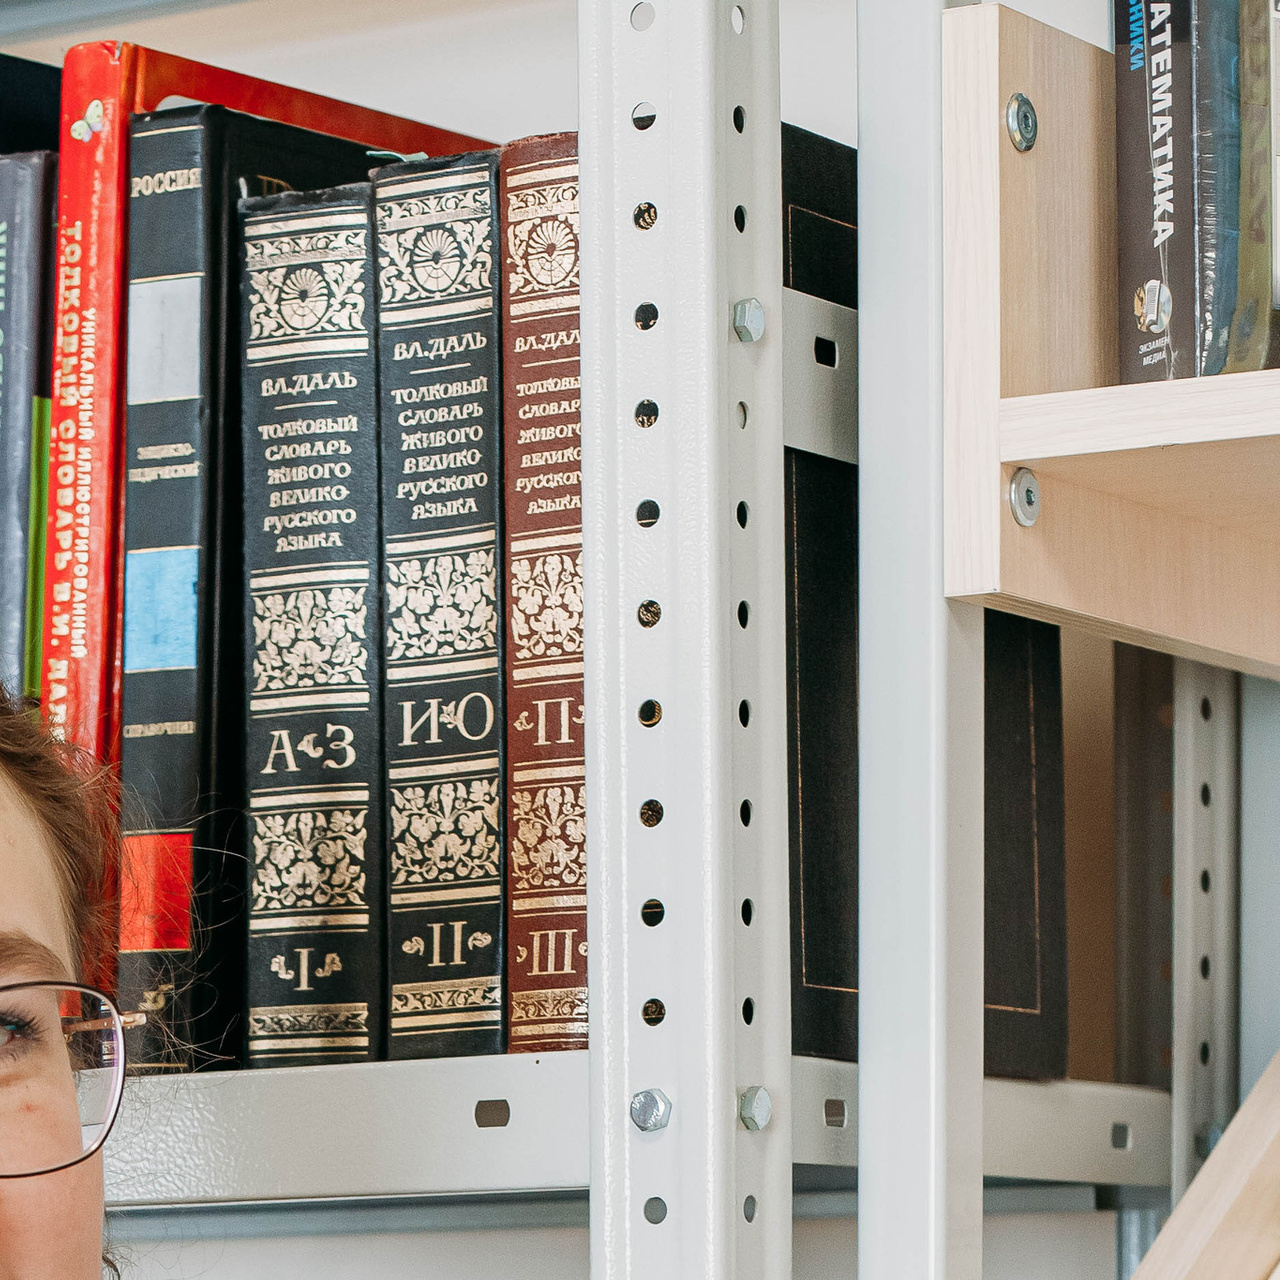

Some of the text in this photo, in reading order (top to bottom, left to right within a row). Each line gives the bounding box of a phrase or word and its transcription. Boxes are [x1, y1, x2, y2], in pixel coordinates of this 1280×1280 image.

[131, 168, 202, 198] РОССИЯ
[55, 221, 81, 408] ТОЛКОВЫЙ
[393, 332, 487, 361] ВЛ.ДАЛЬ
[262, 372, 357, 397] ВЛ.ДАЛЬ
[391, 376, 488, 405] ТОЛКОВЫЙ
[258, 414, 358, 440] ТОЛКОВЫЙ
[398, 402, 484, 426] СЛОВАРЬ
[265, 440, 352, 461] СЛОВАРЬ
[401, 425, 483, 451] ЖИВОГО
[70, 307, 96, 660] УНИКАЛЬНЫЙ ИЛЛЮСТРИРОВАННЫЙ
[268, 462, 351, 485] ЖИВОГО
[396, 472, 488, 499] РУССКОГО
[516, 470, 581, 494] РУССКОГ
[53, 418, 76, 571] СЛОВАРЬ
[263, 508, 356, 534] РУССКОГО
[411, 497, 478, 520] ЯЗЫКА
[276, 532, 342, 553] ЯЗЫКА
[532, 697, 576, 746] П
